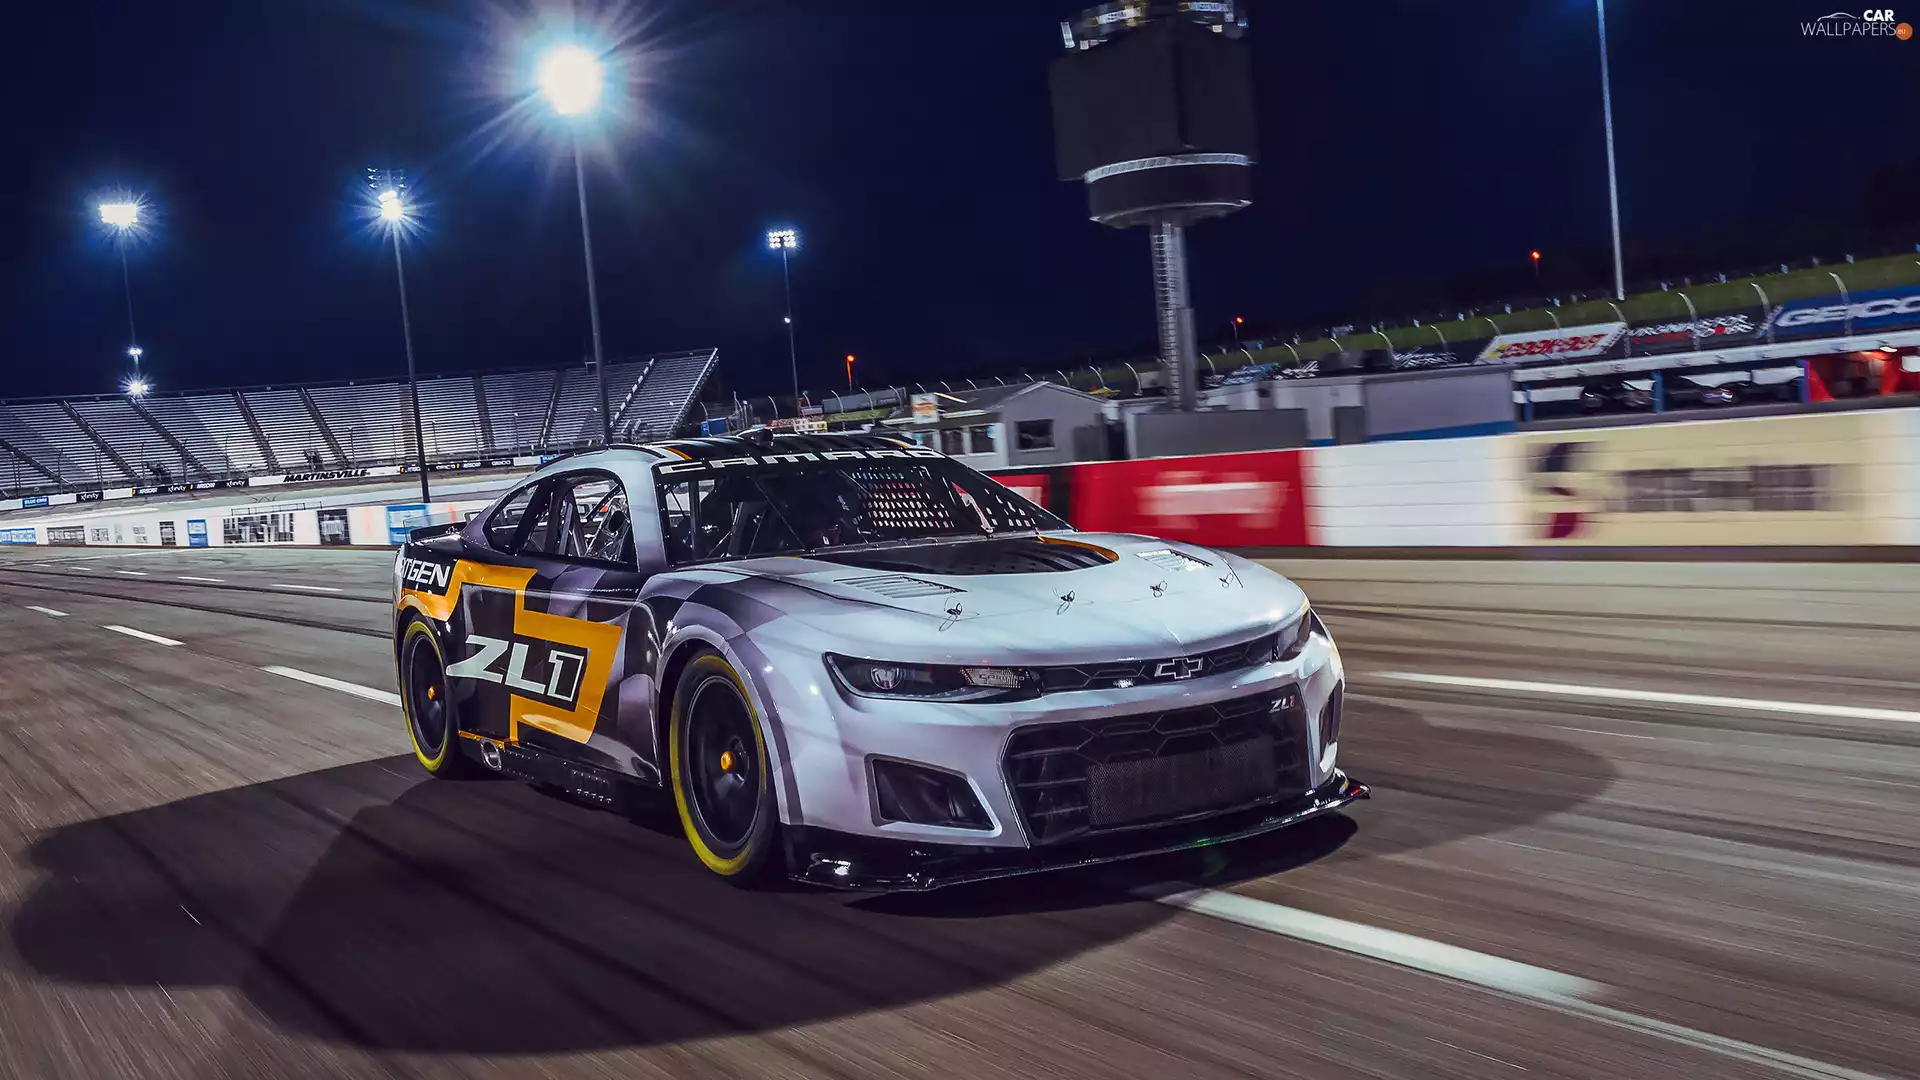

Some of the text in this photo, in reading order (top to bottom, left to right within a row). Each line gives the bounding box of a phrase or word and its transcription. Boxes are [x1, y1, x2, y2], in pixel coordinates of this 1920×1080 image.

[658, 450, 945, 475] CAMARO
[283, 469, 367, 482] MARTINSVILLE
[446, 634, 584, 702] ZL1
